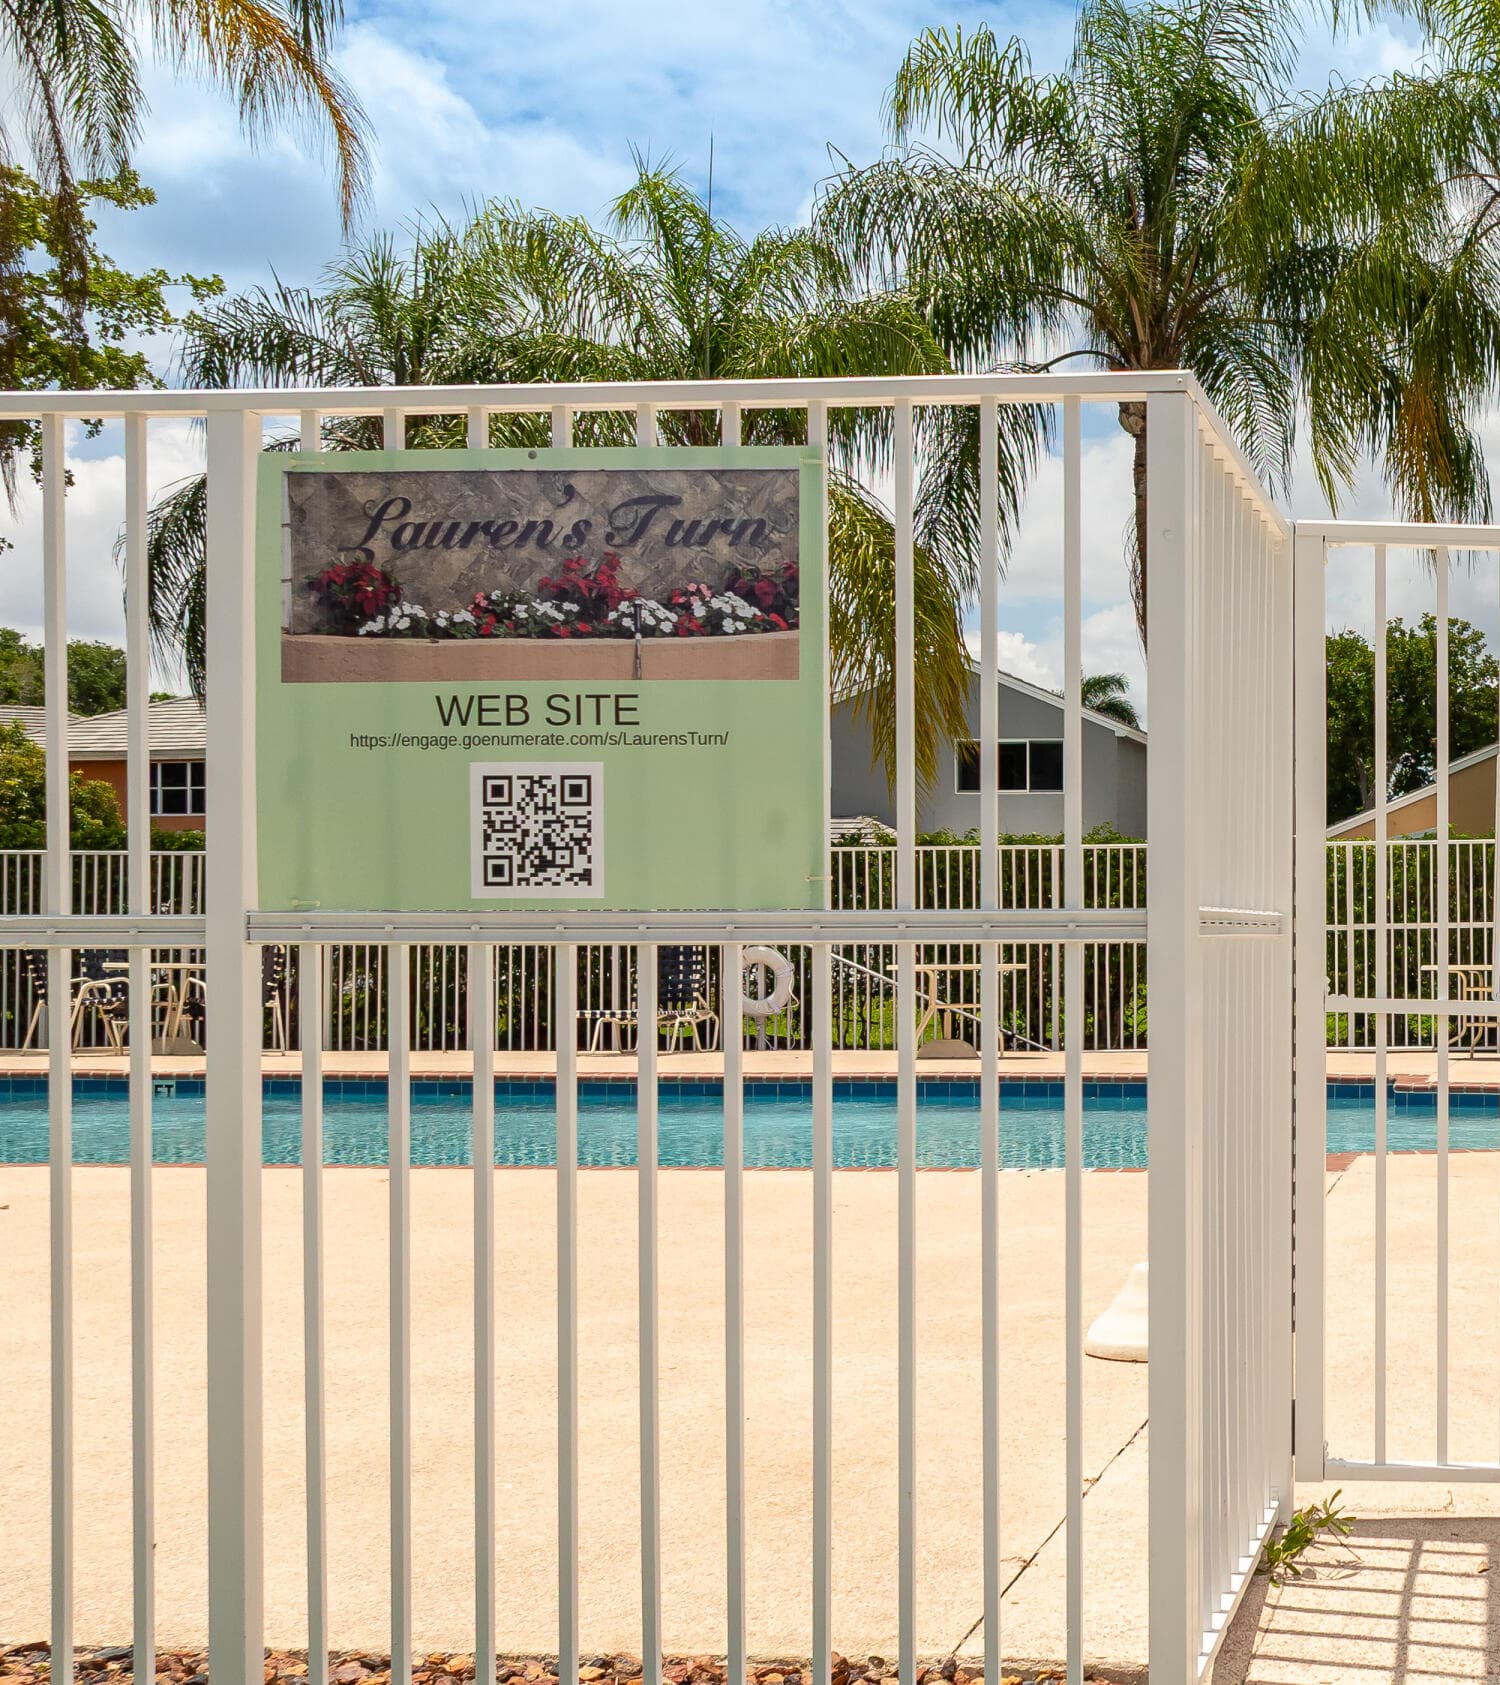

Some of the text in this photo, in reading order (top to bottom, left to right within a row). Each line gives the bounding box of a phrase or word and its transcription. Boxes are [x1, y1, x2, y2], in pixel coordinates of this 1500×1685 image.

[338, 484, 770, 563] Lauren's Turn
[435, 693, 640, 727] WEB SITE
[349, 730, 728, 751] https://engage.goenumerate.com/s/LaurensTurn/
